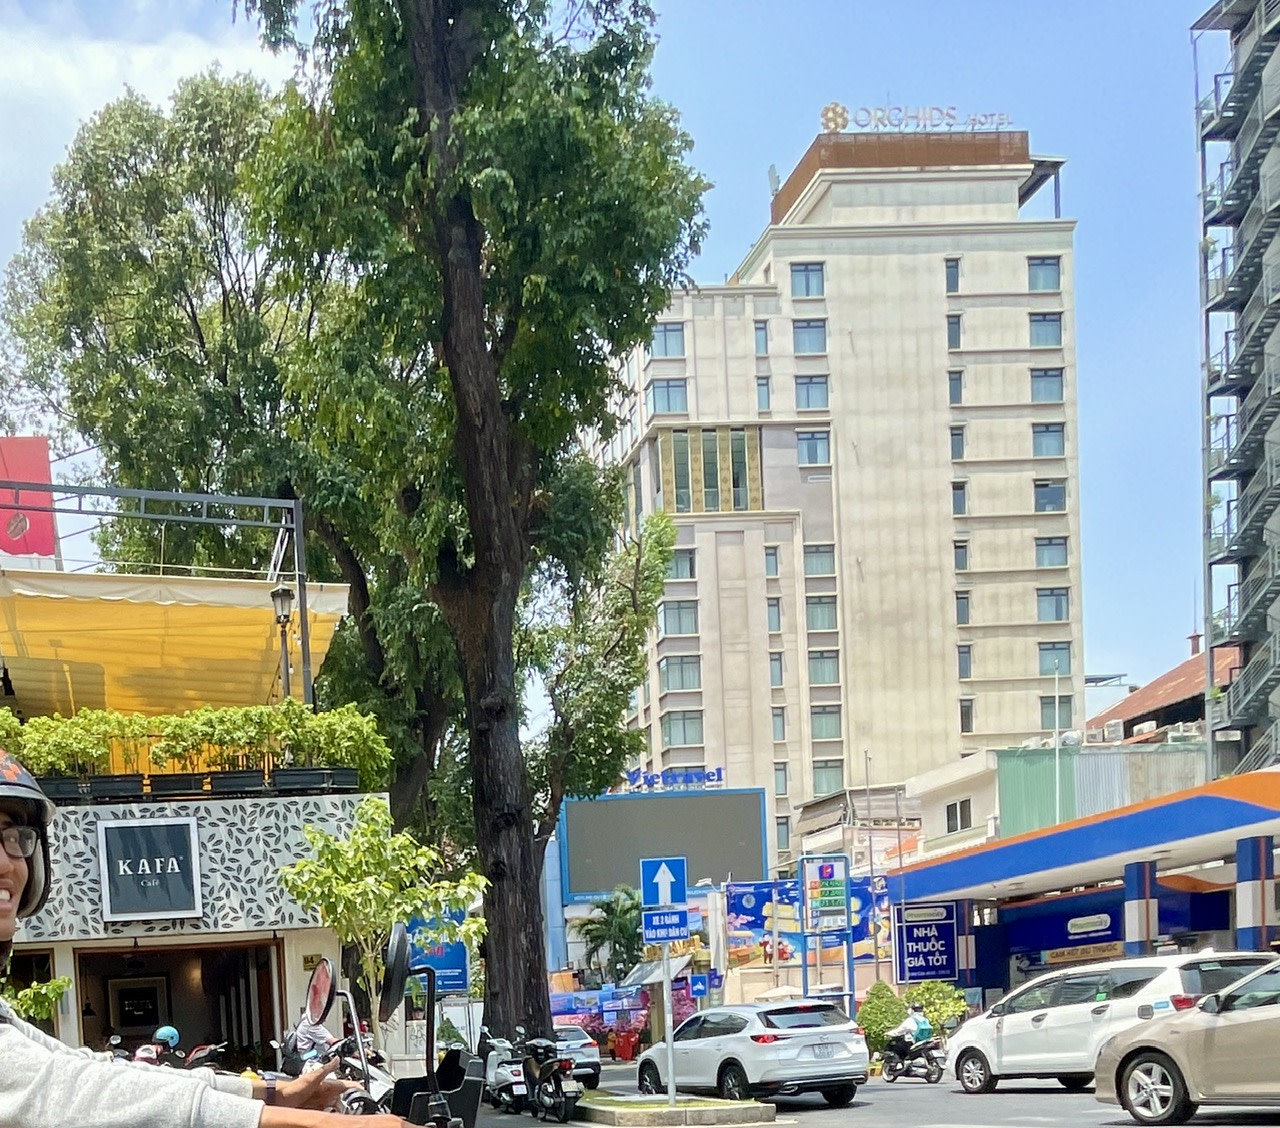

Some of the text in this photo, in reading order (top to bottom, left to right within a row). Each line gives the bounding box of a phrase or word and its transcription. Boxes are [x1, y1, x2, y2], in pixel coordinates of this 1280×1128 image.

[854, 106, 1014, 127] ORCHIDS HOTEL
[625, 767, 724, 787] Vietravel
[118, 856, 181, 875] KAFA
[913, 924, 938, 938] NHÀ
[906, 937, 946, 953] THUỐC
[907, 951, 948, 967] GIÁ TỐT
